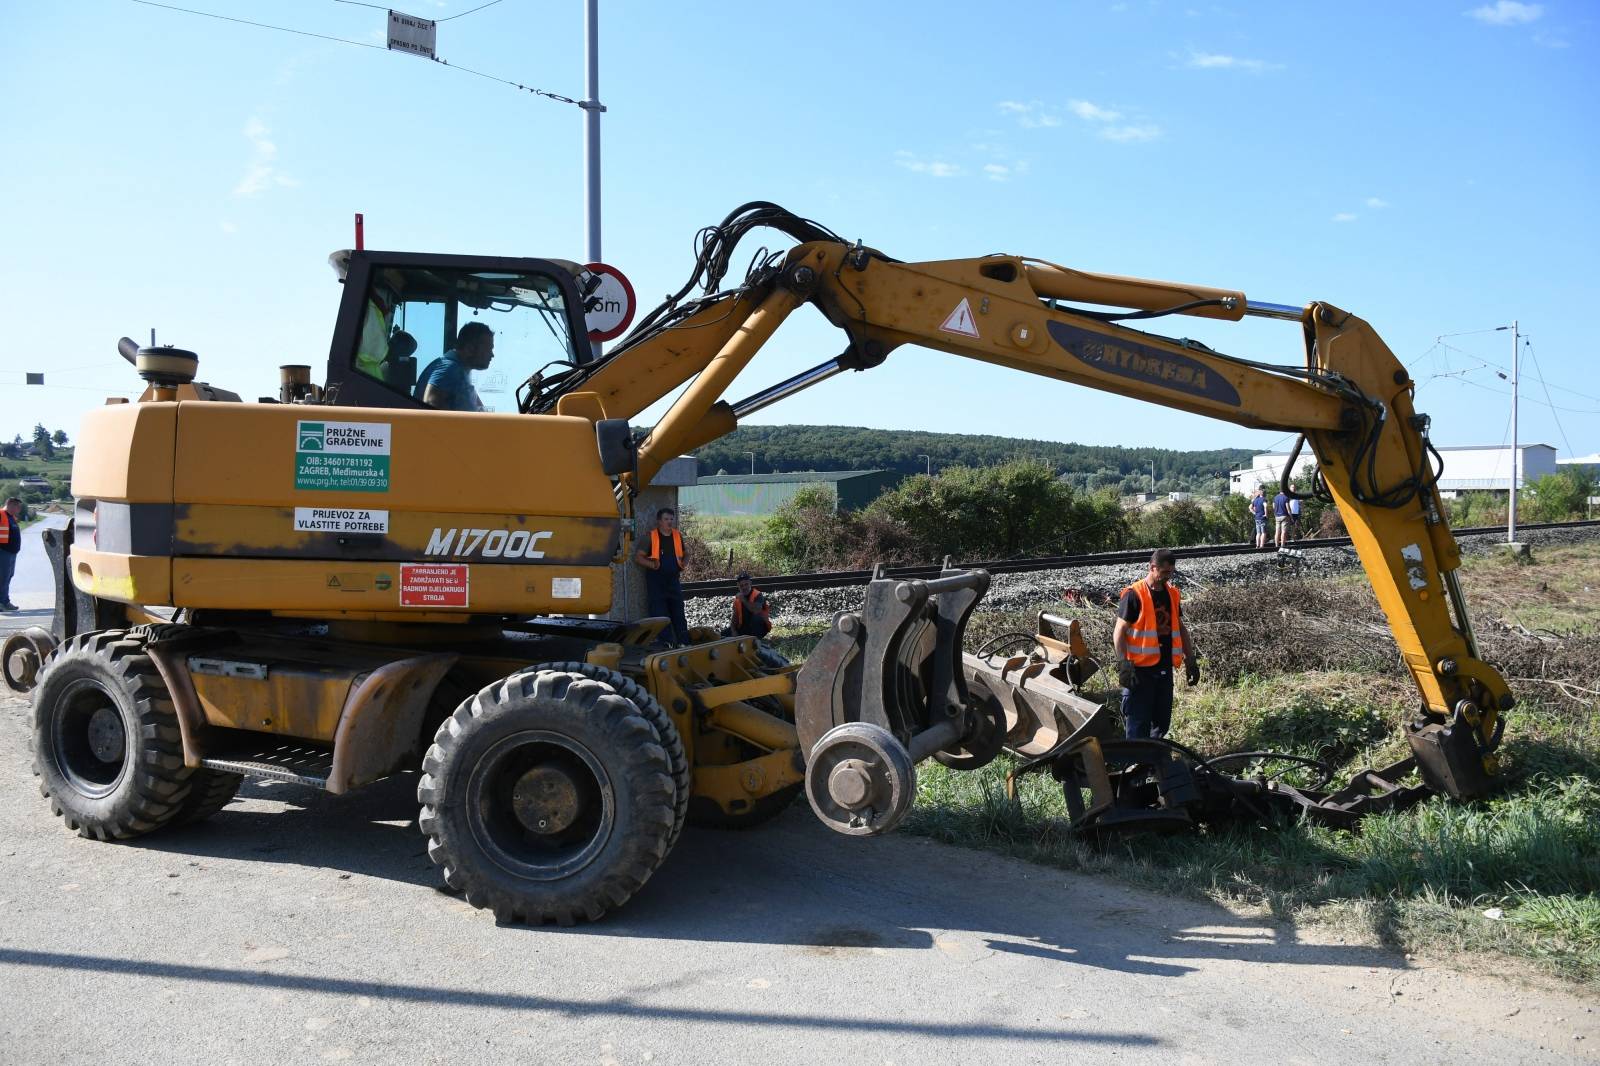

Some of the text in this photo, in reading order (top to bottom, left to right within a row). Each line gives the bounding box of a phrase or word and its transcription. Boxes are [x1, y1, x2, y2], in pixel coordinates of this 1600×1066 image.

[326, 428, 365, 438] PRUŽNE
[326, 438, 383, 447] GRAĐEVINE
[306, 457, 373, 466] OIB: 34601781192
[299, 466, 331, 476] ZAGREB,
[379, 469, 384, 477] 4
[312, 510, 371, 520] PRIJEVOZ ZA
[298, 520, 385, 531] VLASTITE POTREBE
